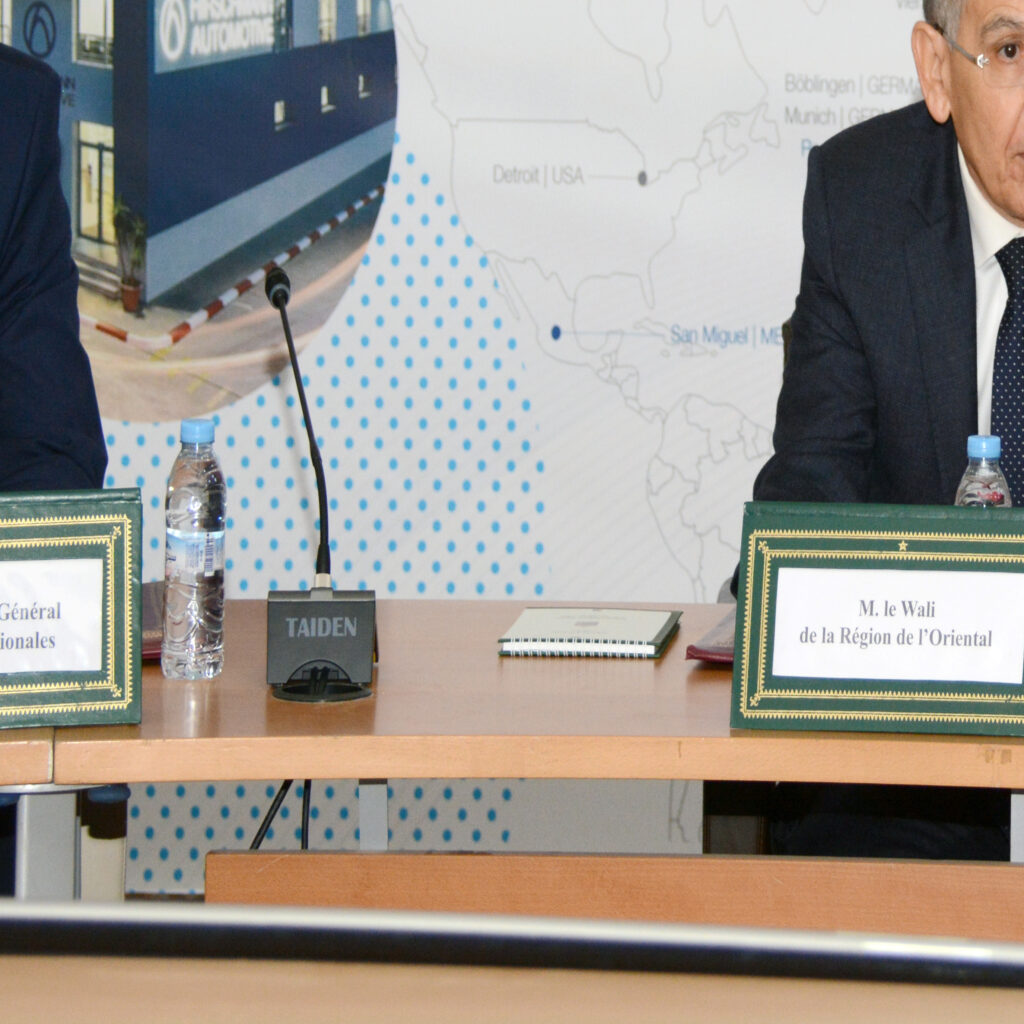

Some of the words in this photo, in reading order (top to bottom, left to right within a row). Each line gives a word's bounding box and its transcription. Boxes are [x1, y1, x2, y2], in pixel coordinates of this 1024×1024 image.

[784, 72, 856, 98] Böblingen
[784, 105, 837, 126] Munich
[492, 163, 540, 185] Detroit
[551, 164, 585, 185] USA
[671, 323, 699, 345] San
[702, 324, 749, 350] Miguel
[0, 601, 62, 622] Général
[858, 599, 879, 618] M.
[884, 599, 897, 618] le
[901, 599, 936, 619] Wali
[285, 616, 358, 638] TAIDEN
[799, 626, 818, 645] de
[821, 626, 835, 645] la
[839, 626, 892, 649] Région
[896, 628, 914, 647] de
